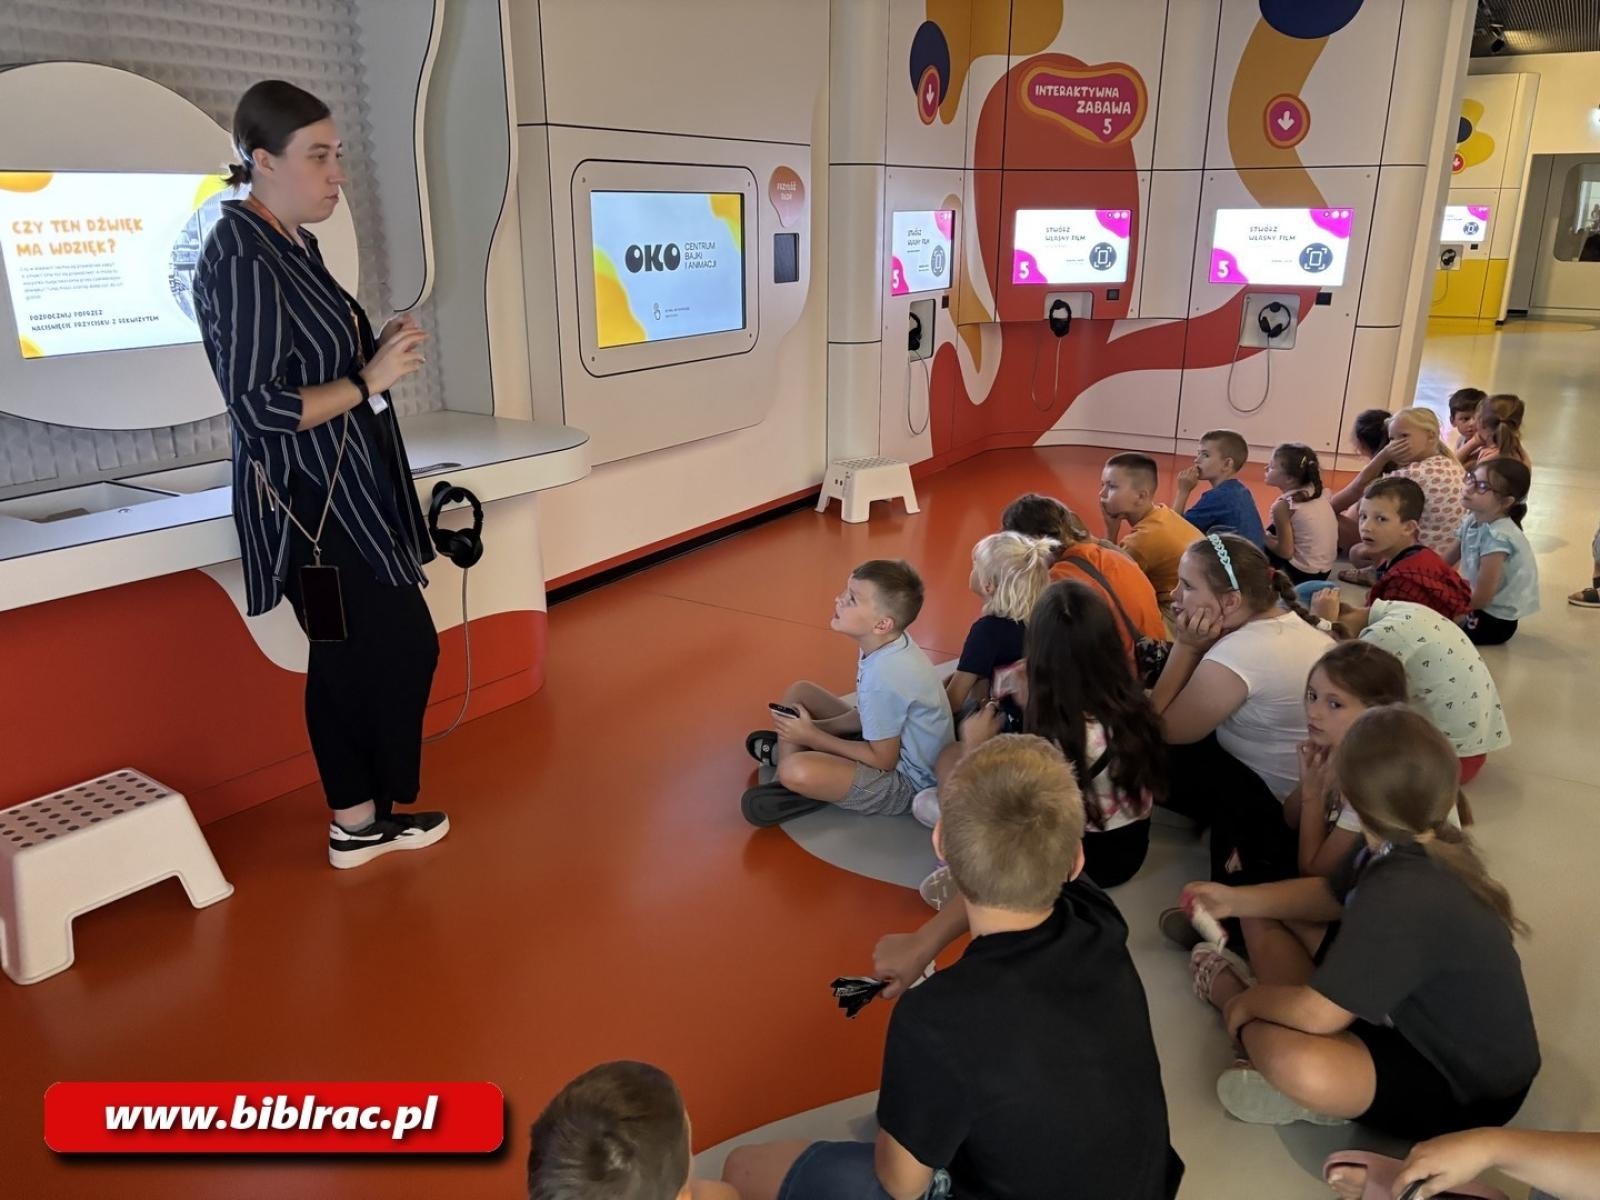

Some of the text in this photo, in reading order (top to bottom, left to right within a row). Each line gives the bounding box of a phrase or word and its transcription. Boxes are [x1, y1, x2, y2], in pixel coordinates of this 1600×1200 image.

[1035, 85, 1120, 98] INTERAKTYWNA
[1076, 100, 1131, 115] ZABAWA
[1102, 118, 1112, 135] 5
[12, 220, 43, 235] CZY
[51, 219, 81, 233] TEN
[16, 238, 116, 256] MA WDZIĘK?
[684, 241, 716, 251] CENTRUM
[625, 242, 681, 274] OKO
[684, 250, 703, 261] BAJKI
[1019, 261, 1030, 280] 5
[1217, 260, 1231, 279] 5
[892, 269, 900, 289] 5
